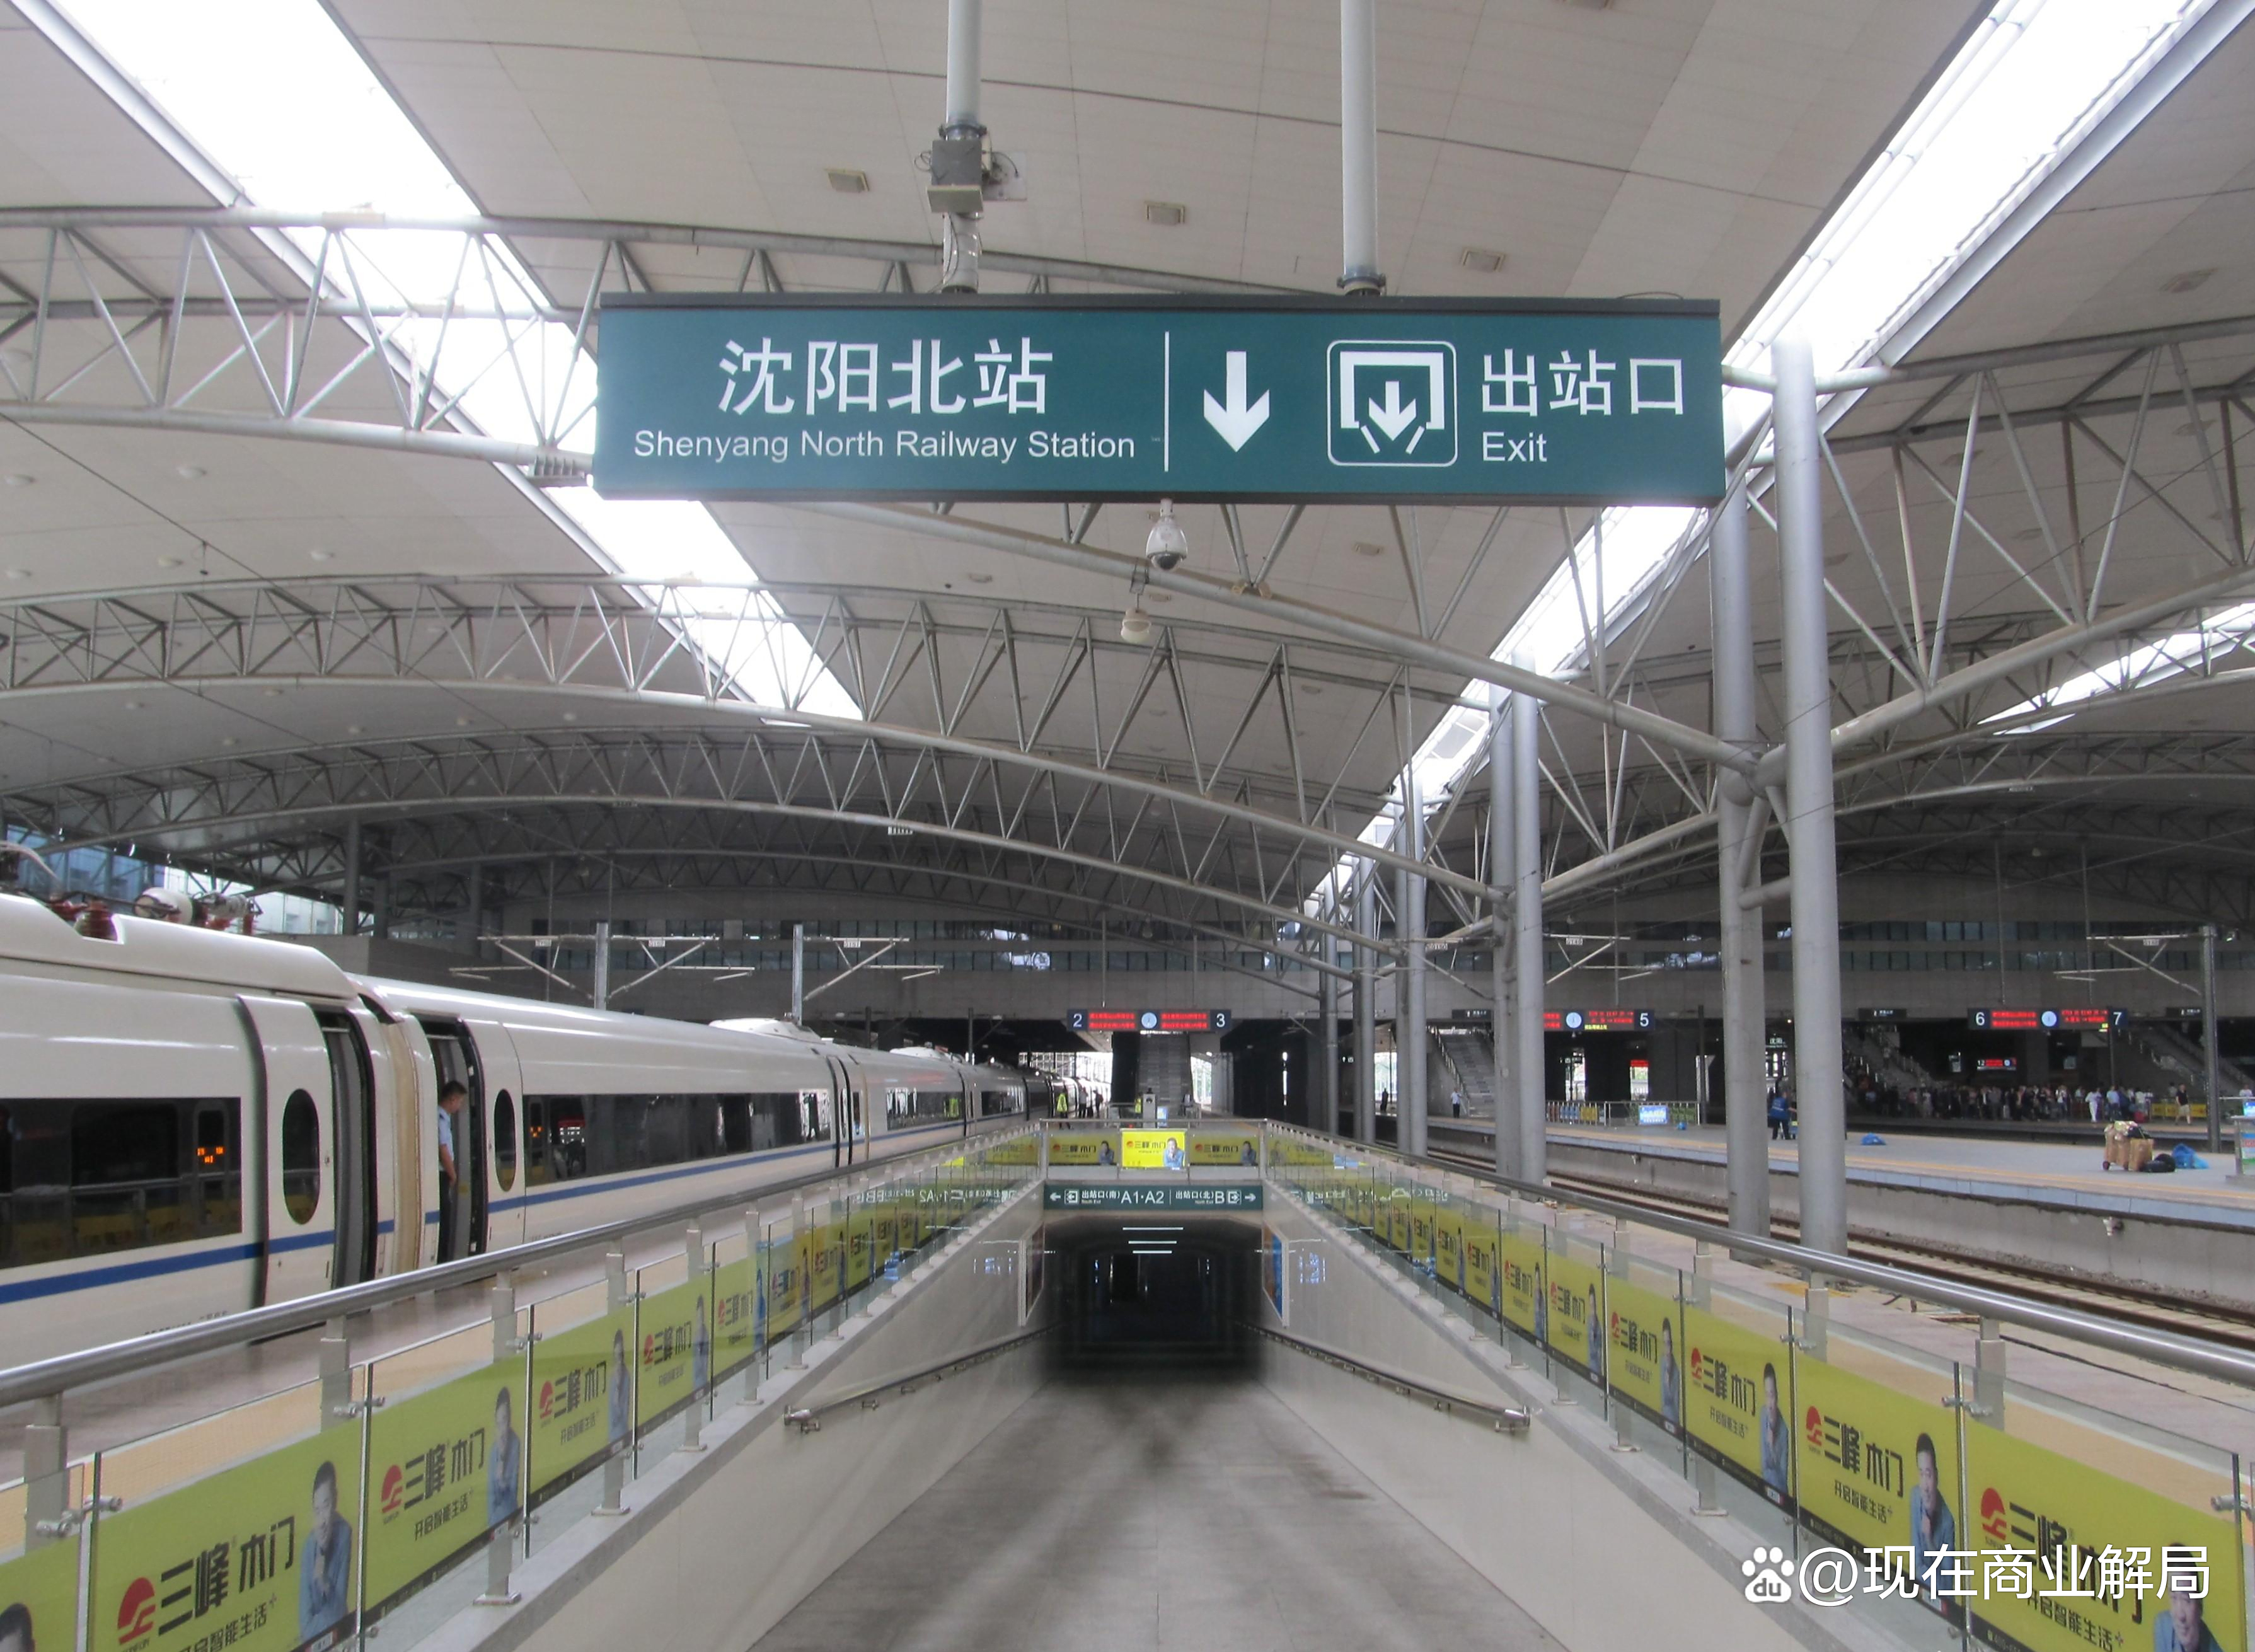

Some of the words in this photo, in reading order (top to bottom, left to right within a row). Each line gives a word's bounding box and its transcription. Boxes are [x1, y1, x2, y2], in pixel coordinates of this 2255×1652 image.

[718, 337, 1053, 415] 沈阳北站
[1482, 349, 1683, 417] 出站口
[635, 430, 788, 463] Shenyang
[802, 430, 883, 456] North
[897, 430, 1017, 464] Railway
[1028, 430, 1134, 458] Station
[1482, 431, 1547, 462] Exit
[1073, 1013, 1082, 1027] 2
[1216, 1013, 1225, 1027] 3
[1639, 1012, 1649, 1027] 5
[1975, 1012, 1985, 1025] 6
[2113, 1012, 2122, 1025] 7
[1214, 1191, 1225, 1204] B
[404, 1427, 485, 1511] 三峰木门
[1823, 1415, 1904, 1499] 三峰木门
[159, 1515, 294, 1636] 三峰木门
